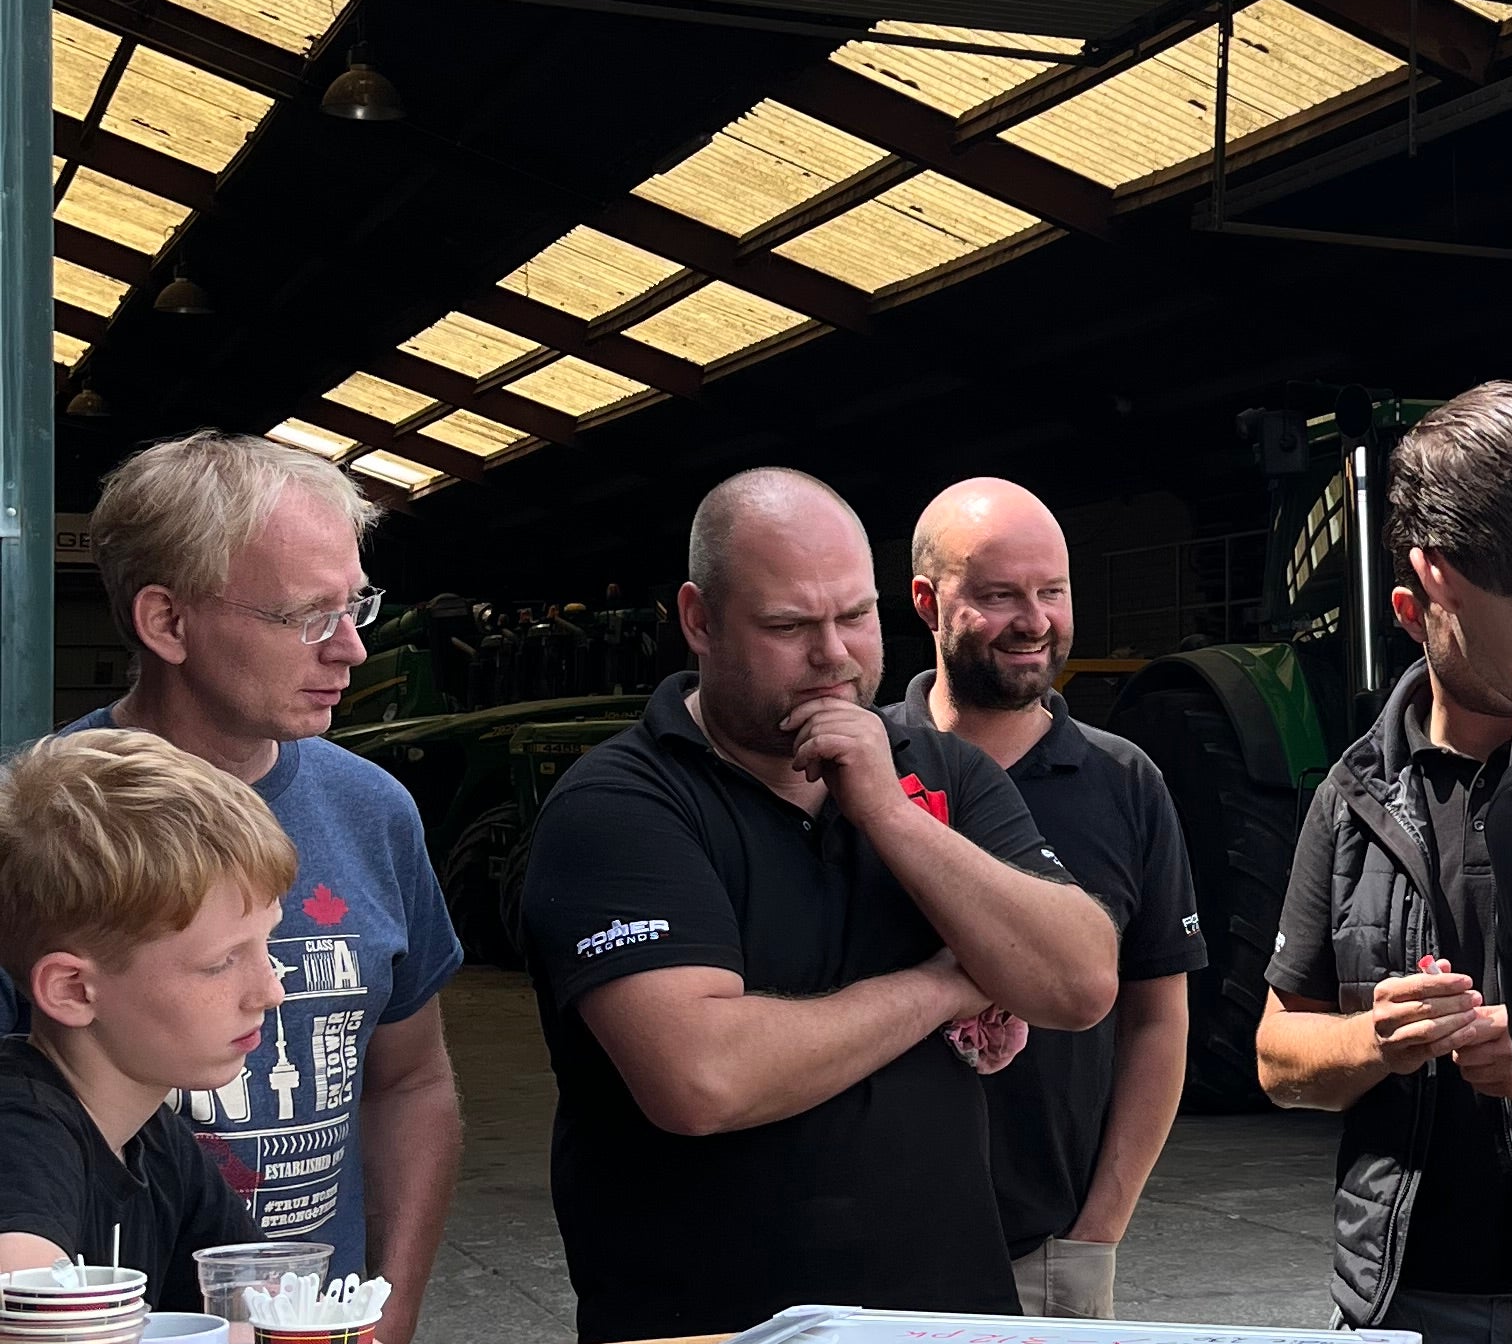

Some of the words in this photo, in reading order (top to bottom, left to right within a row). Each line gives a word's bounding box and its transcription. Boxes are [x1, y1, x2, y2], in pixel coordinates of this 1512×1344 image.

[586, 931, 660, 958] LEGENDS
[305, 939, 334, 953] CLASS
[333, 940, 359, 990] A
[347, 1009, 365, 1032] CN
[325, 1011, 346, 1078] TOWER
[344, 1034, 358, 1078] TOUR
[327, 1082, 342, 1109] CN
[343, 1080, 353, 1102] LA
[264, 1154, 332, 1181] ESTABLISHED
